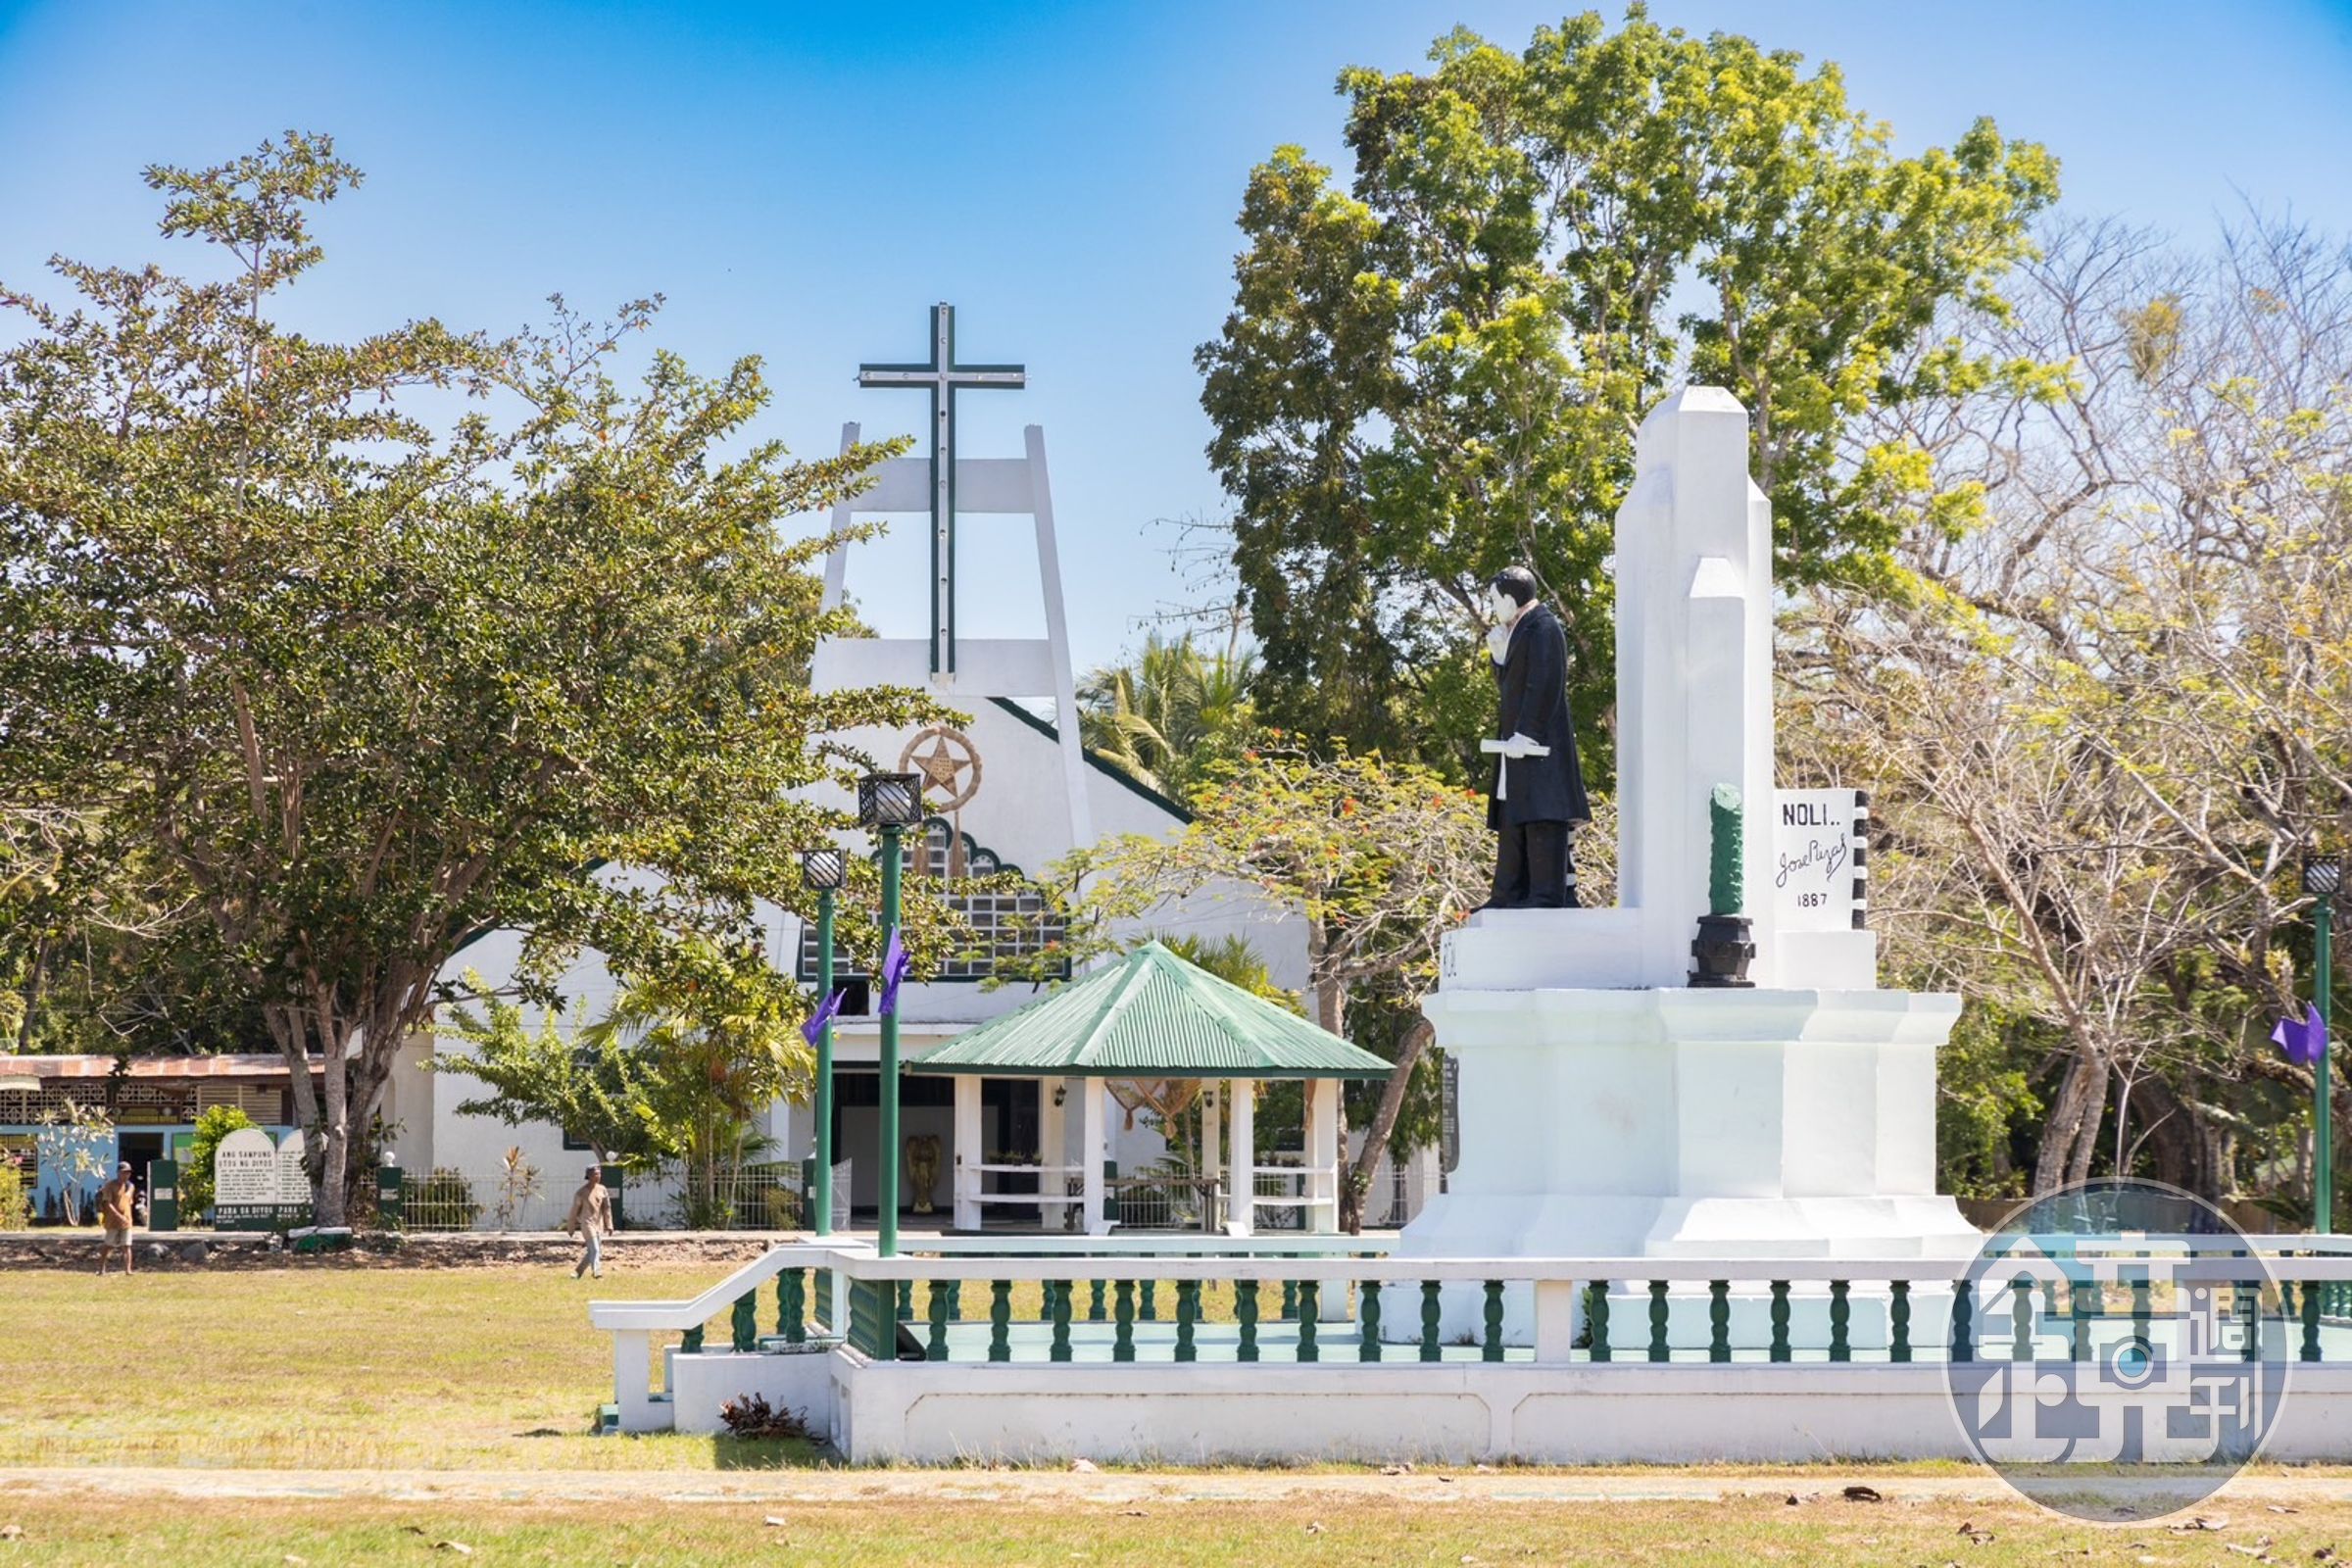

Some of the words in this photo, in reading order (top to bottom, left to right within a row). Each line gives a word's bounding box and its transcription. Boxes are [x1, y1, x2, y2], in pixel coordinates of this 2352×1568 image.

[1783, 803, 1840, 826] NOLI..
[1797, 893, 1828, 907] 1887
[219, 1206, 237, 1215] PARA
